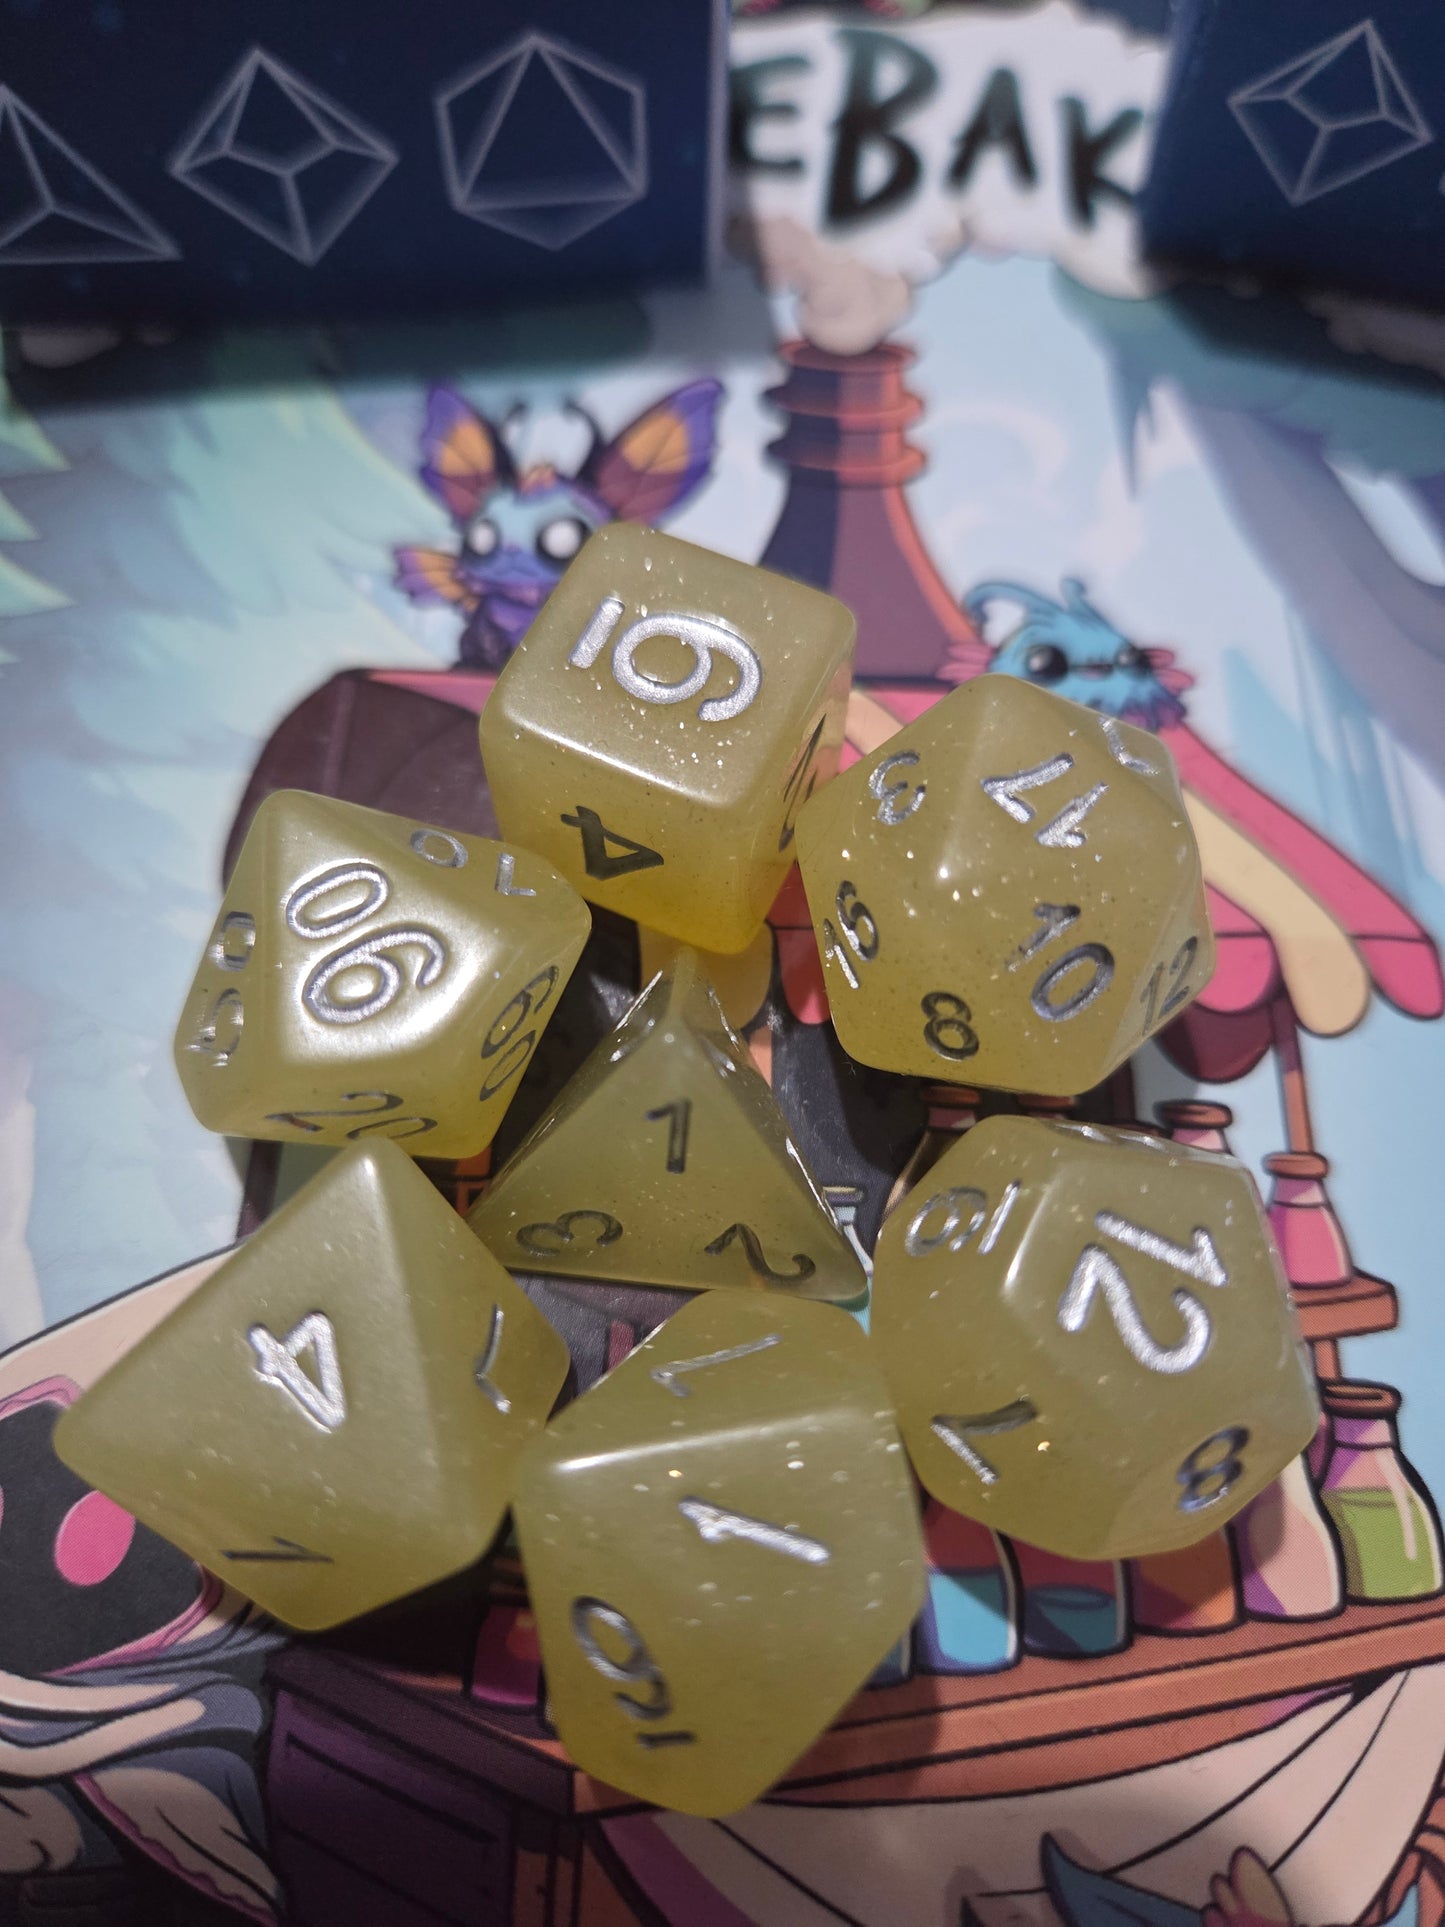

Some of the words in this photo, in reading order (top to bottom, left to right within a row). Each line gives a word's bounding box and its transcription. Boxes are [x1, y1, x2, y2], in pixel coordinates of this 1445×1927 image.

[868, 749, 927, 826] 3
[979, 751, 1111, 849] 17
[560, 805, 665, 881] 4
[1004, 902, 1116, 1023] 10
[920, 990, 981, 1062] 8
[645, 1098, 693, 1175] 1
[515, 1208, 625, 1258] 3
[704, 1222, 817, 1285] 2
[1057, 1208, 1230, 1376] 12
[247, 1309, 347, 1434] 4
[930, 1394, 1039, 1487] 7
[1176, 1425, 1251, 1514] 8
[678, 1495, 831, 1565] 1
